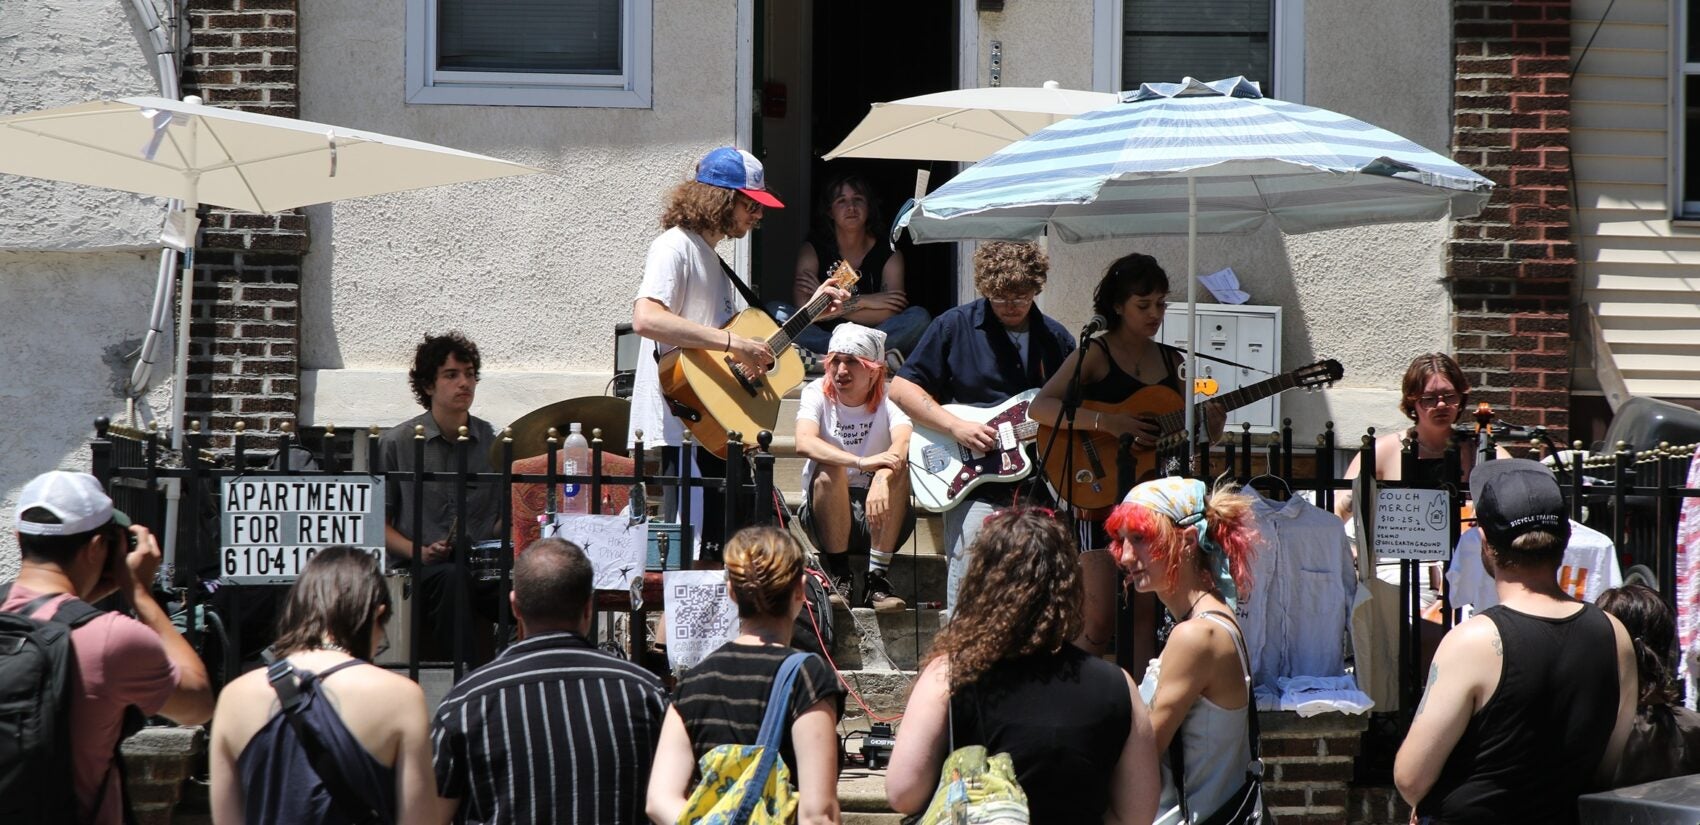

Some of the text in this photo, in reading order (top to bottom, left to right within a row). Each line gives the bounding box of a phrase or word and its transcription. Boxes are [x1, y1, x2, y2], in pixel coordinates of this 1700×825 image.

[227, 482, 370, 512] APARTMENT
[1379, 492, 1420, 500] COUCH
[1379, 503, 1420, 512] MERCH
[1509, 515, 1535, 528] BICYCLE
[234, 515, 362, 544] FOR RENT
